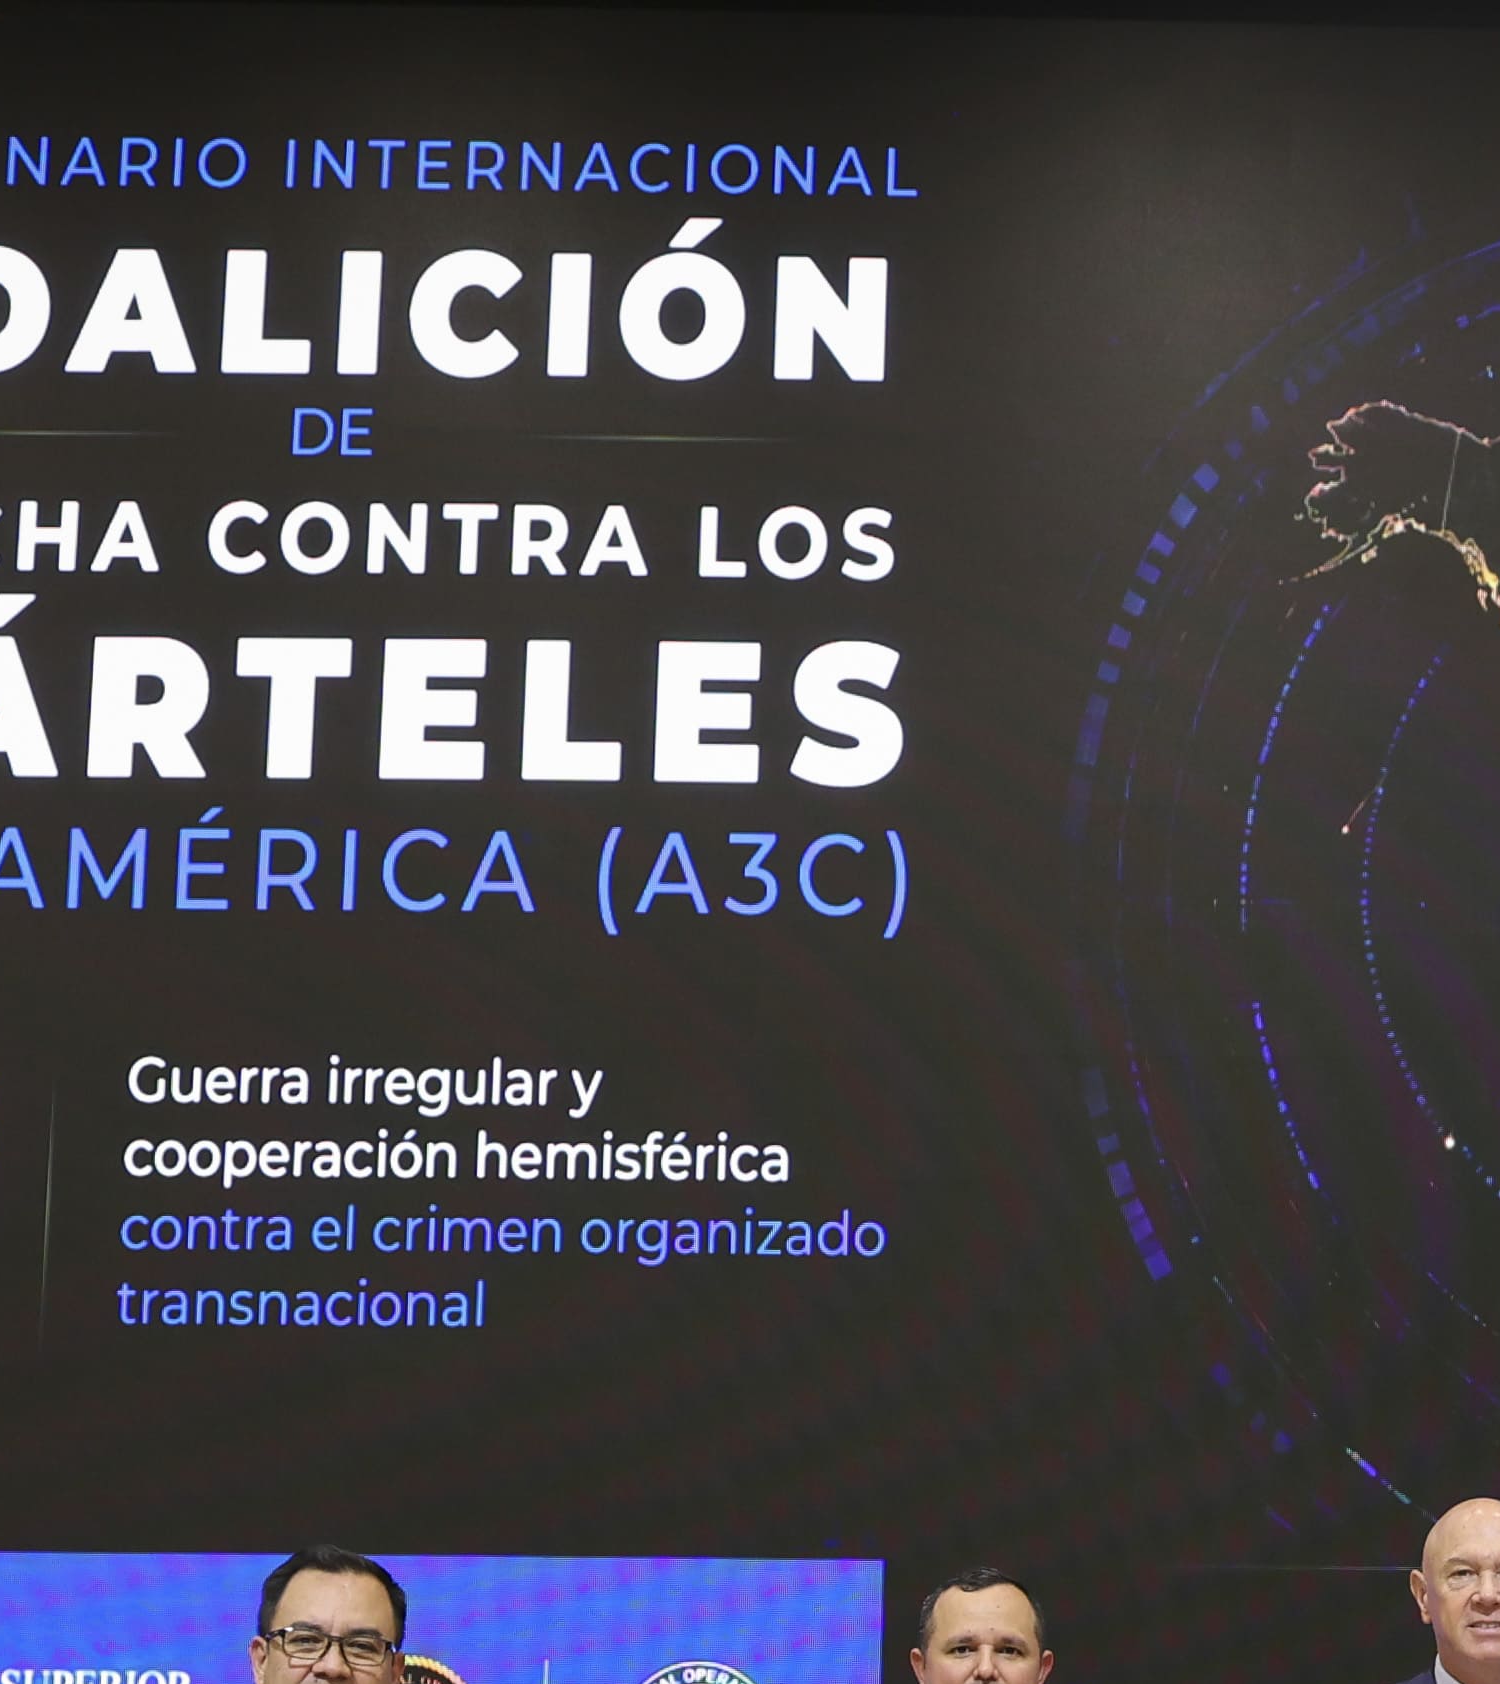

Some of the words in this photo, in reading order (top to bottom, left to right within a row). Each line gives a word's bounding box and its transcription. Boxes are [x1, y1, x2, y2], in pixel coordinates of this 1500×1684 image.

[285, 138, 919, 198] INTERNACIONAL
[291, 407, 375, 457] DE
[207, 500, 649, 577] CONTRA
[698, 505, 895, 582] LOS
[597, 826, 909, 940] (A3C)
[128, 1055, 310, 1105] Guerra
[328, 1054, 558, 1118] irregular
[568, 1069, 604, 1119] y
[123, 1129, 457, 1189] cooperación
[476, 1129, 789, 1183] hemisférica
[120, 1208, 294, 1253] contra
[311, 1204, 356, 1253] el
[372, 1203, 563, 1255] crimen
[579, 1206, 889, 1267] organizado
[116, 1278, 486, 1329] transnacional
